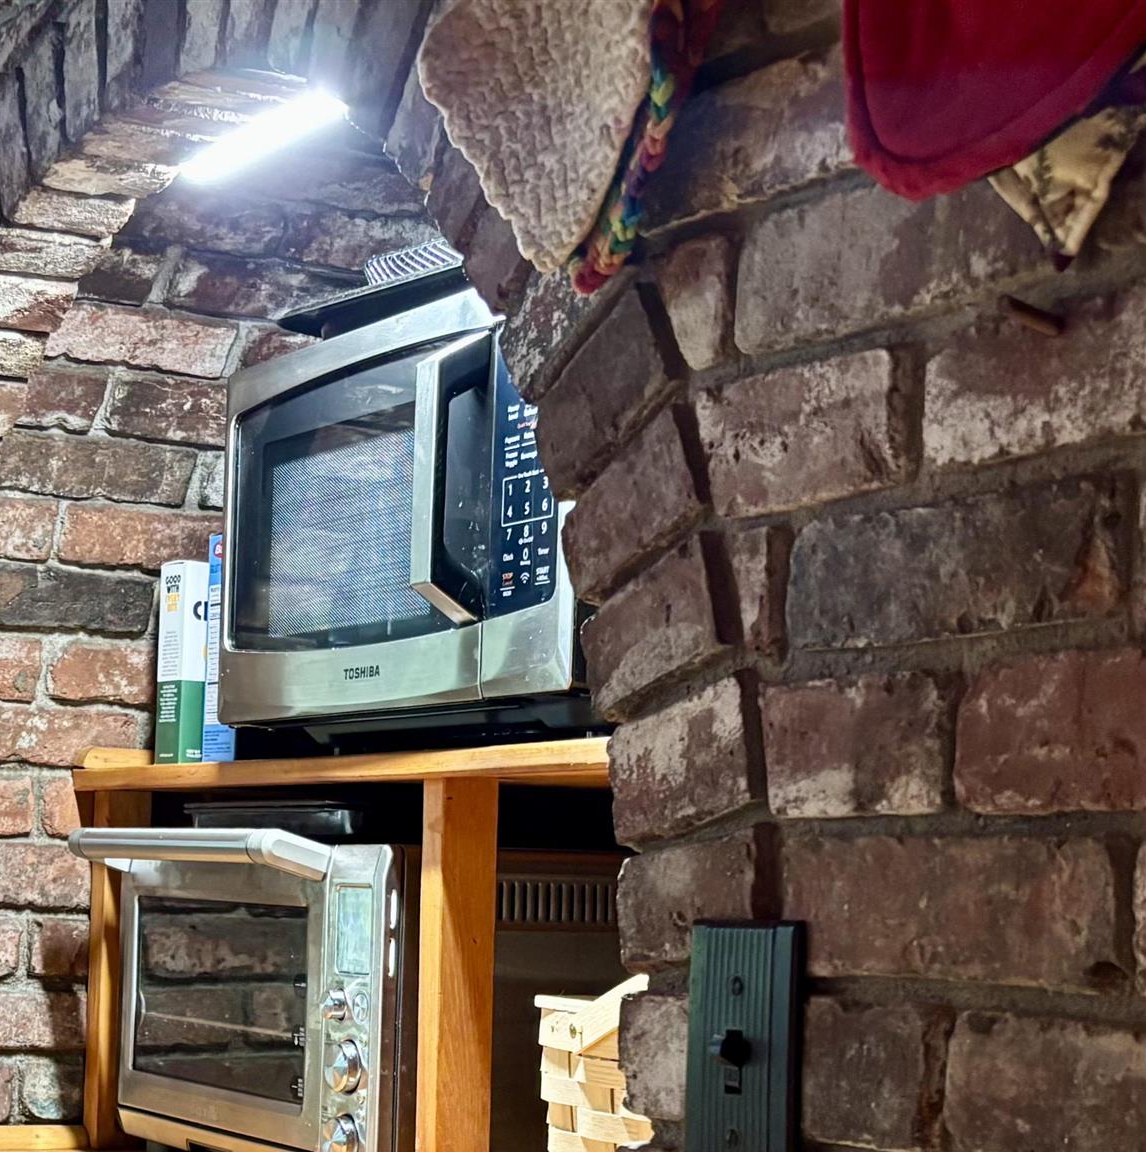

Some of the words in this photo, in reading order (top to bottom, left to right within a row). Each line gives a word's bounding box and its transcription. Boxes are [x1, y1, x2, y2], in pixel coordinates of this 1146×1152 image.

[524, 479, 531, 494] 2
[542, 475, 549, 490] 3
[508, 483, 513, 497] 1
[506, 504, 513, 518] 4
[523, 501, 530, 516] 5
[541, 497, 548, 512] 6
[506, 527, 512, 541] 7
[523, 524, 530, 538] 8
[541, 521, 548, 535] 9
[522, 547, 529, 561] 0
[165, 574, 181, 585] GOOD
[343, 664, 380, 681] TOSHIBA
